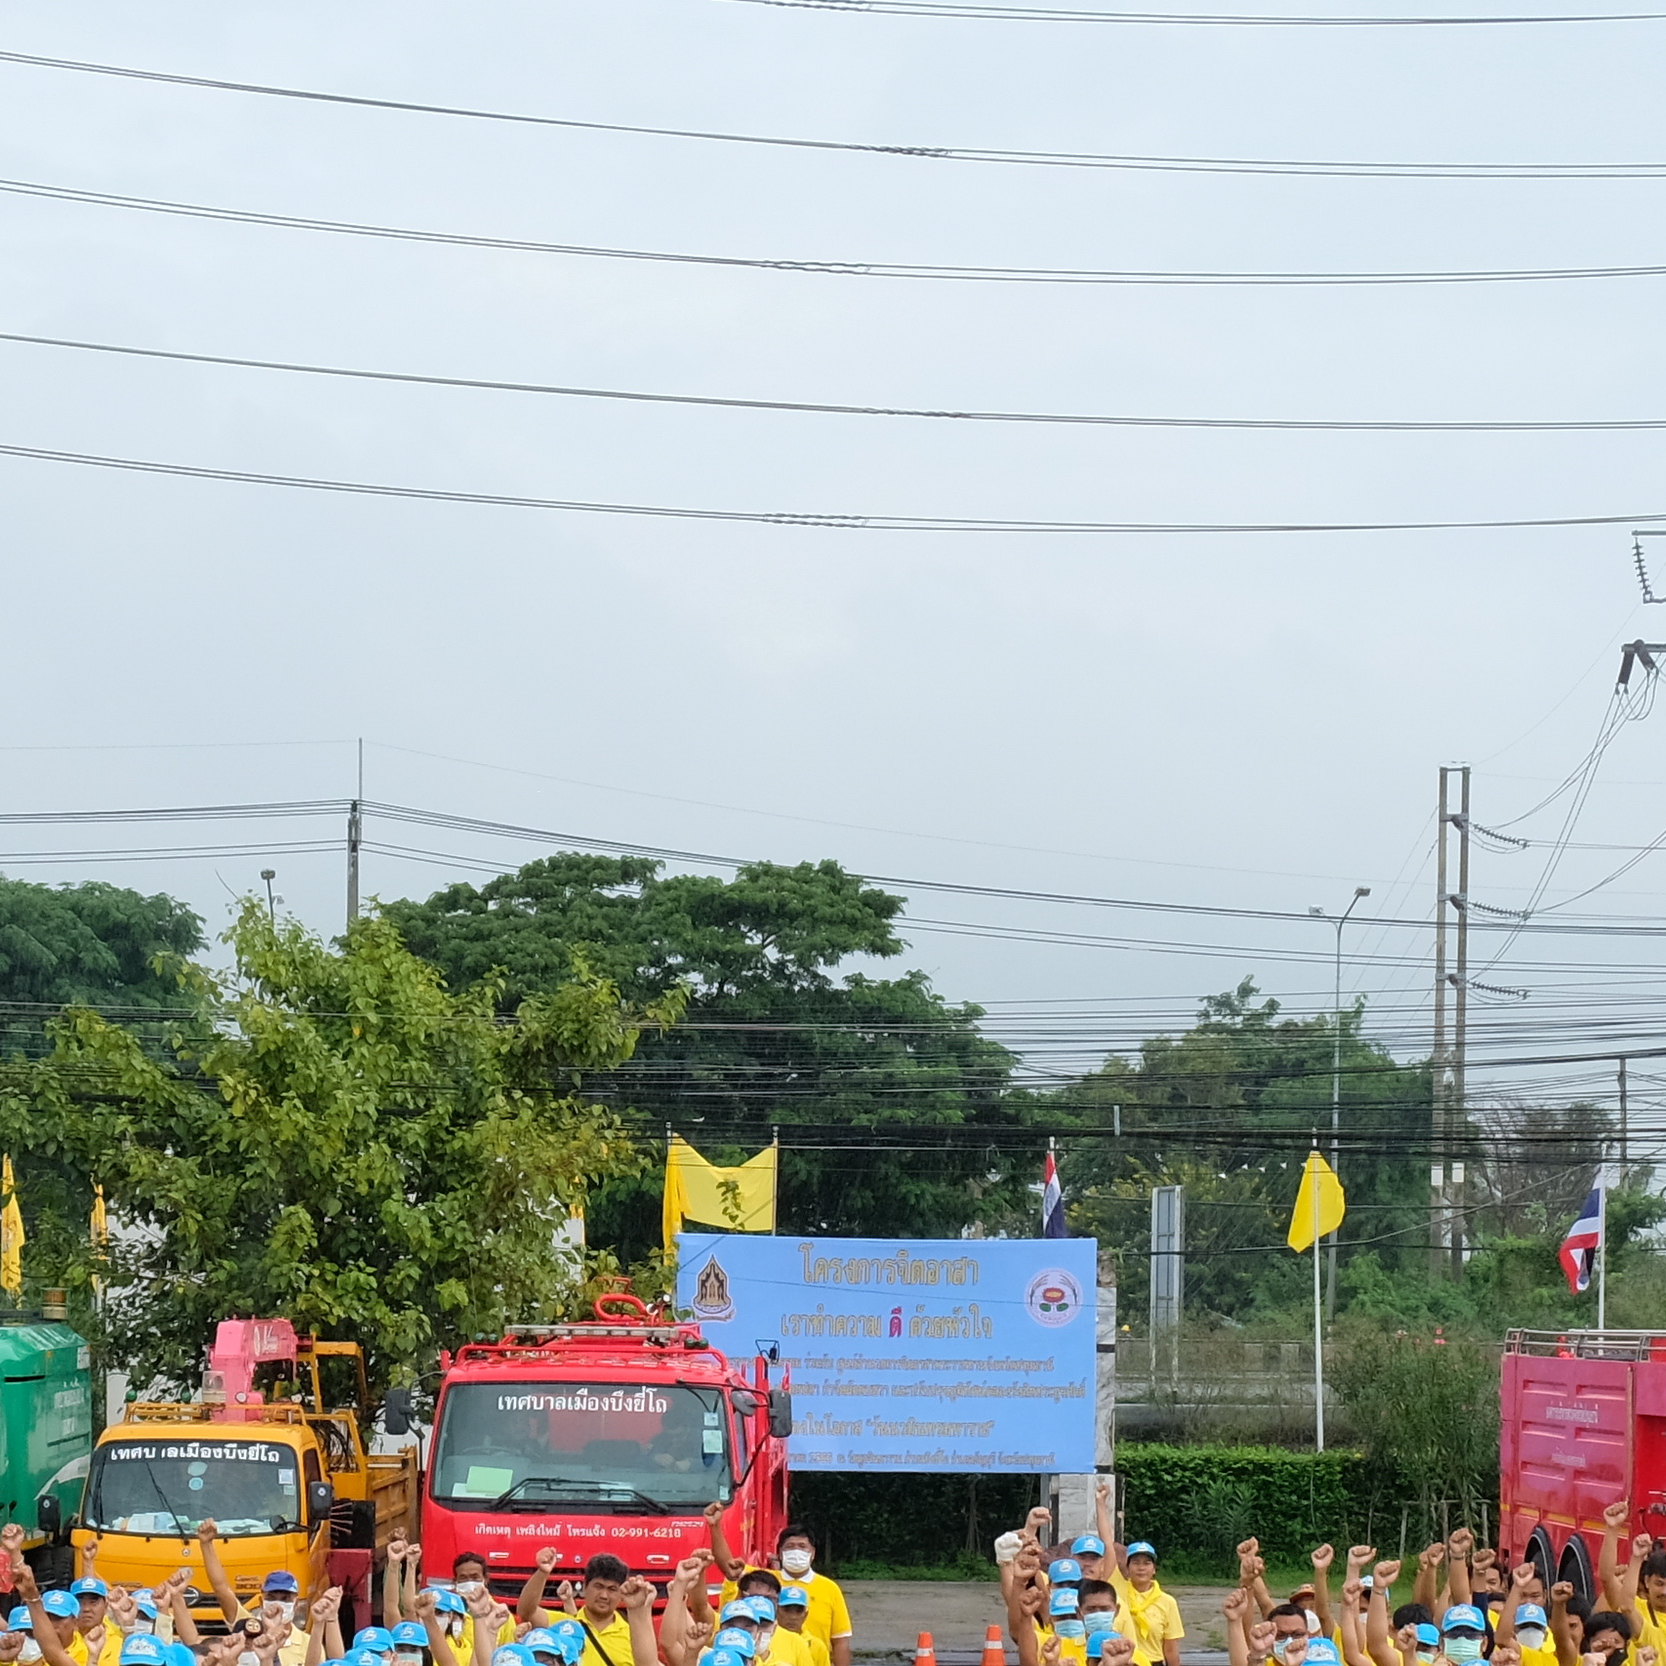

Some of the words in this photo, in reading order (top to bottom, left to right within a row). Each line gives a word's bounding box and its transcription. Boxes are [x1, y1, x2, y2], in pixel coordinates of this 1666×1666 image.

[798, 1242, 979, 1285] โครงการจิตอาสา
[888, 1306, 903, 1338] ดี
[908, 1303, 993, 1338] ด้วยหัวใจ
[497, 1386, 667, 1414] เทศบาลเมืองบึงยี่โถ
